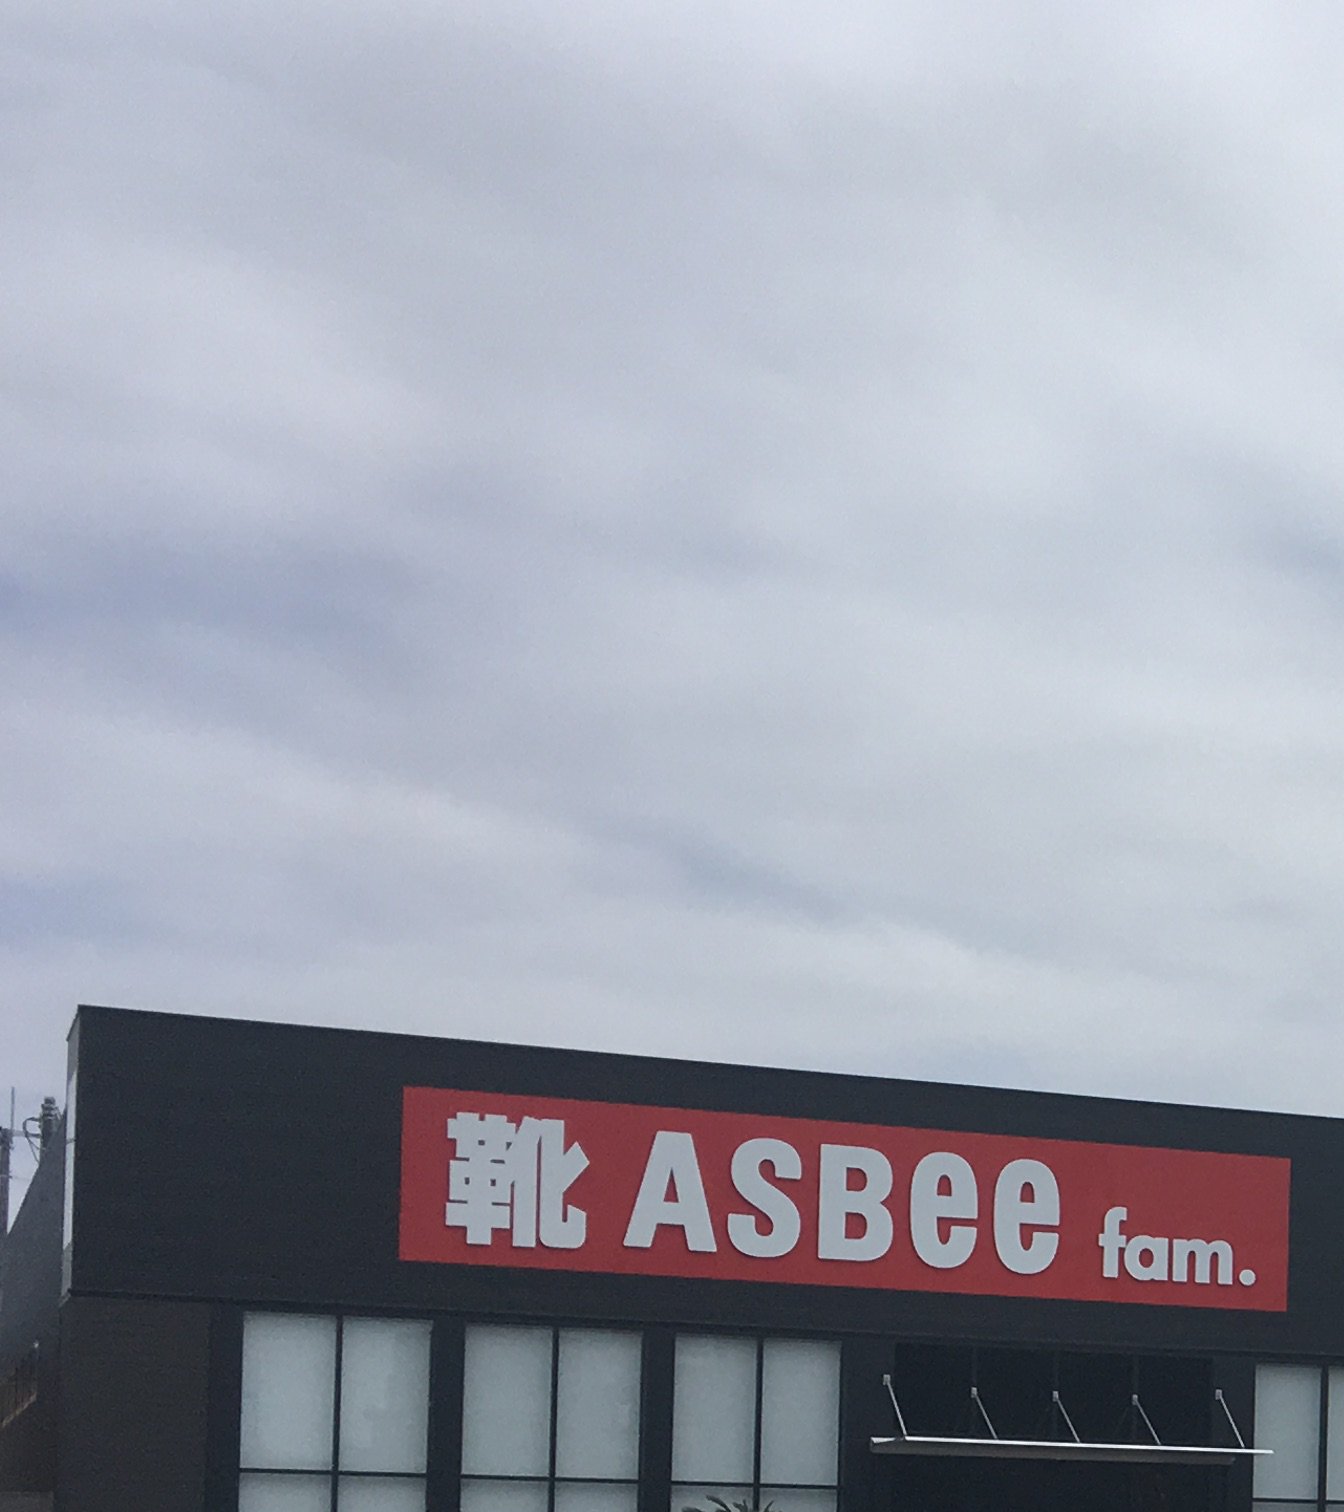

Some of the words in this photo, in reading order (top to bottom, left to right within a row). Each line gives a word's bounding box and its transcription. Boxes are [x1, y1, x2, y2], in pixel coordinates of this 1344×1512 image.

[445, 1110, 591, 1249] 靴
[622, 1130, 1061, 1276] ASBee
[1097, 1205, 1258, 1287] fam.
